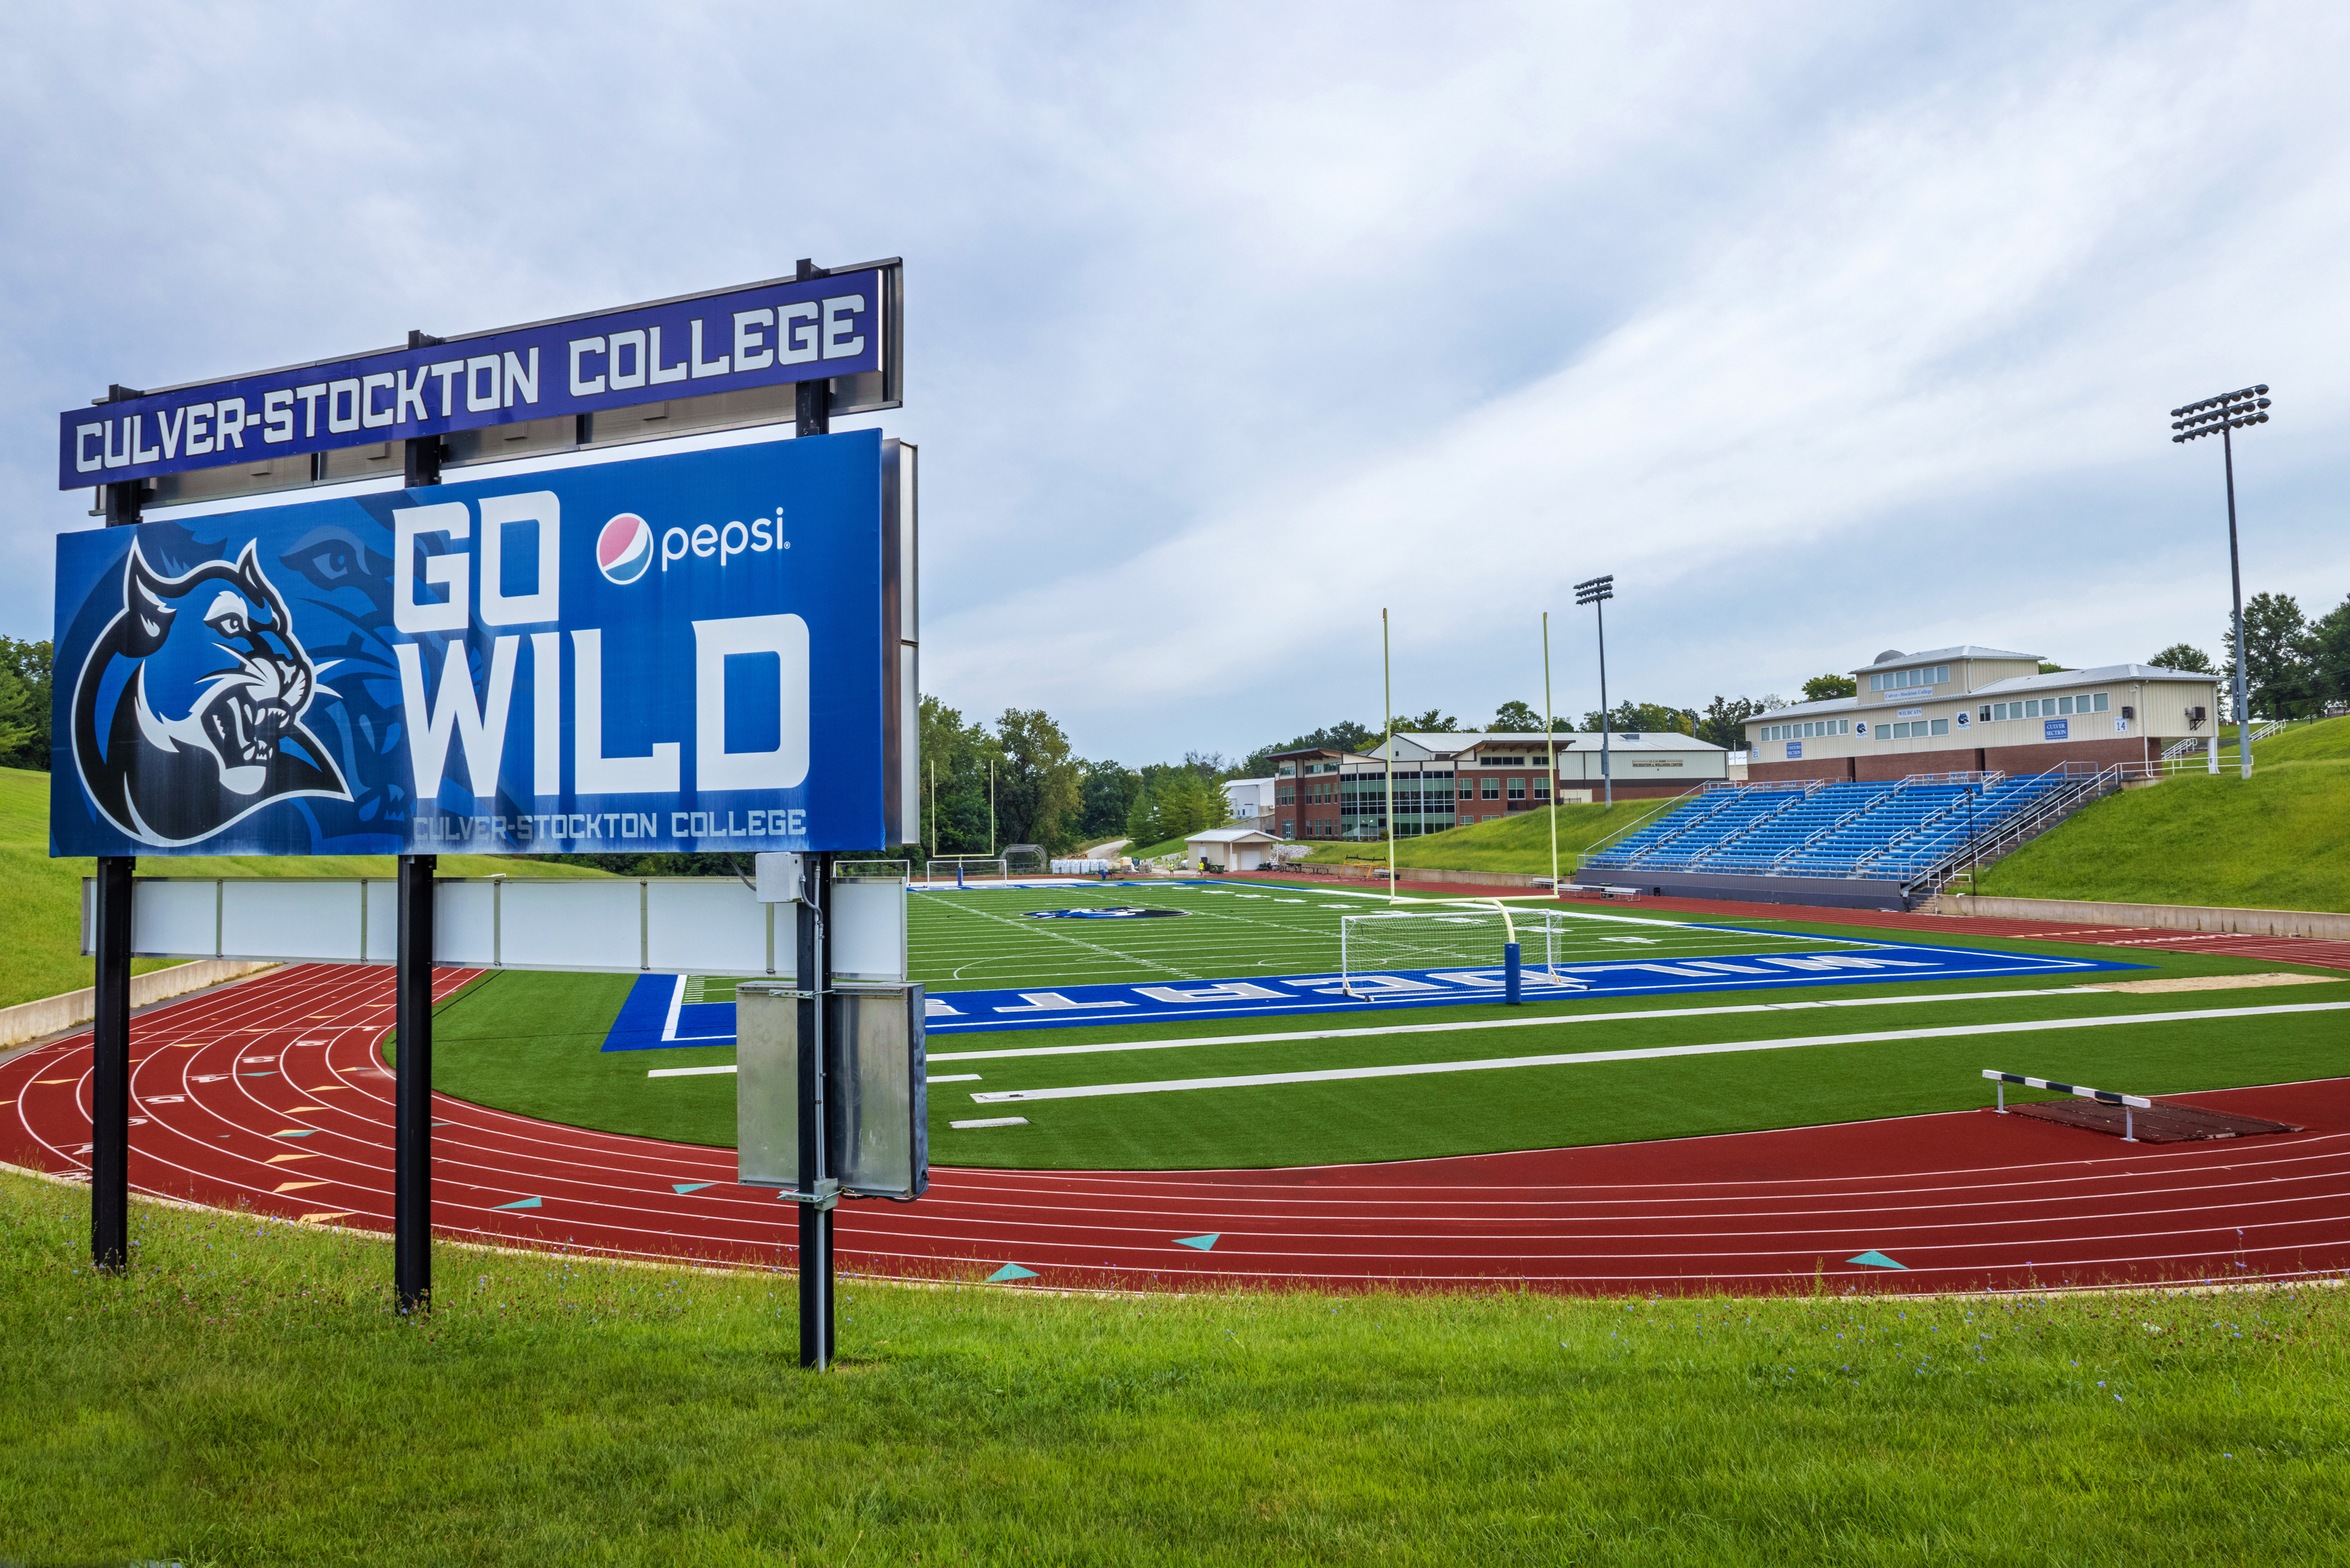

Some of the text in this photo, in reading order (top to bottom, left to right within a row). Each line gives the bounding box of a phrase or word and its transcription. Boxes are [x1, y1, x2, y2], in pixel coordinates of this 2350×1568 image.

[75, 294, 866, 473] CULVER-STOCKTON COLLEGE
[392, 490, 560, 633] GO
[393, 613, 810, 799] WILD
[2117, 721, 2126, 731] 14
[413, 809, 807, 841] CULVER-STOCKTON COLLEGE
